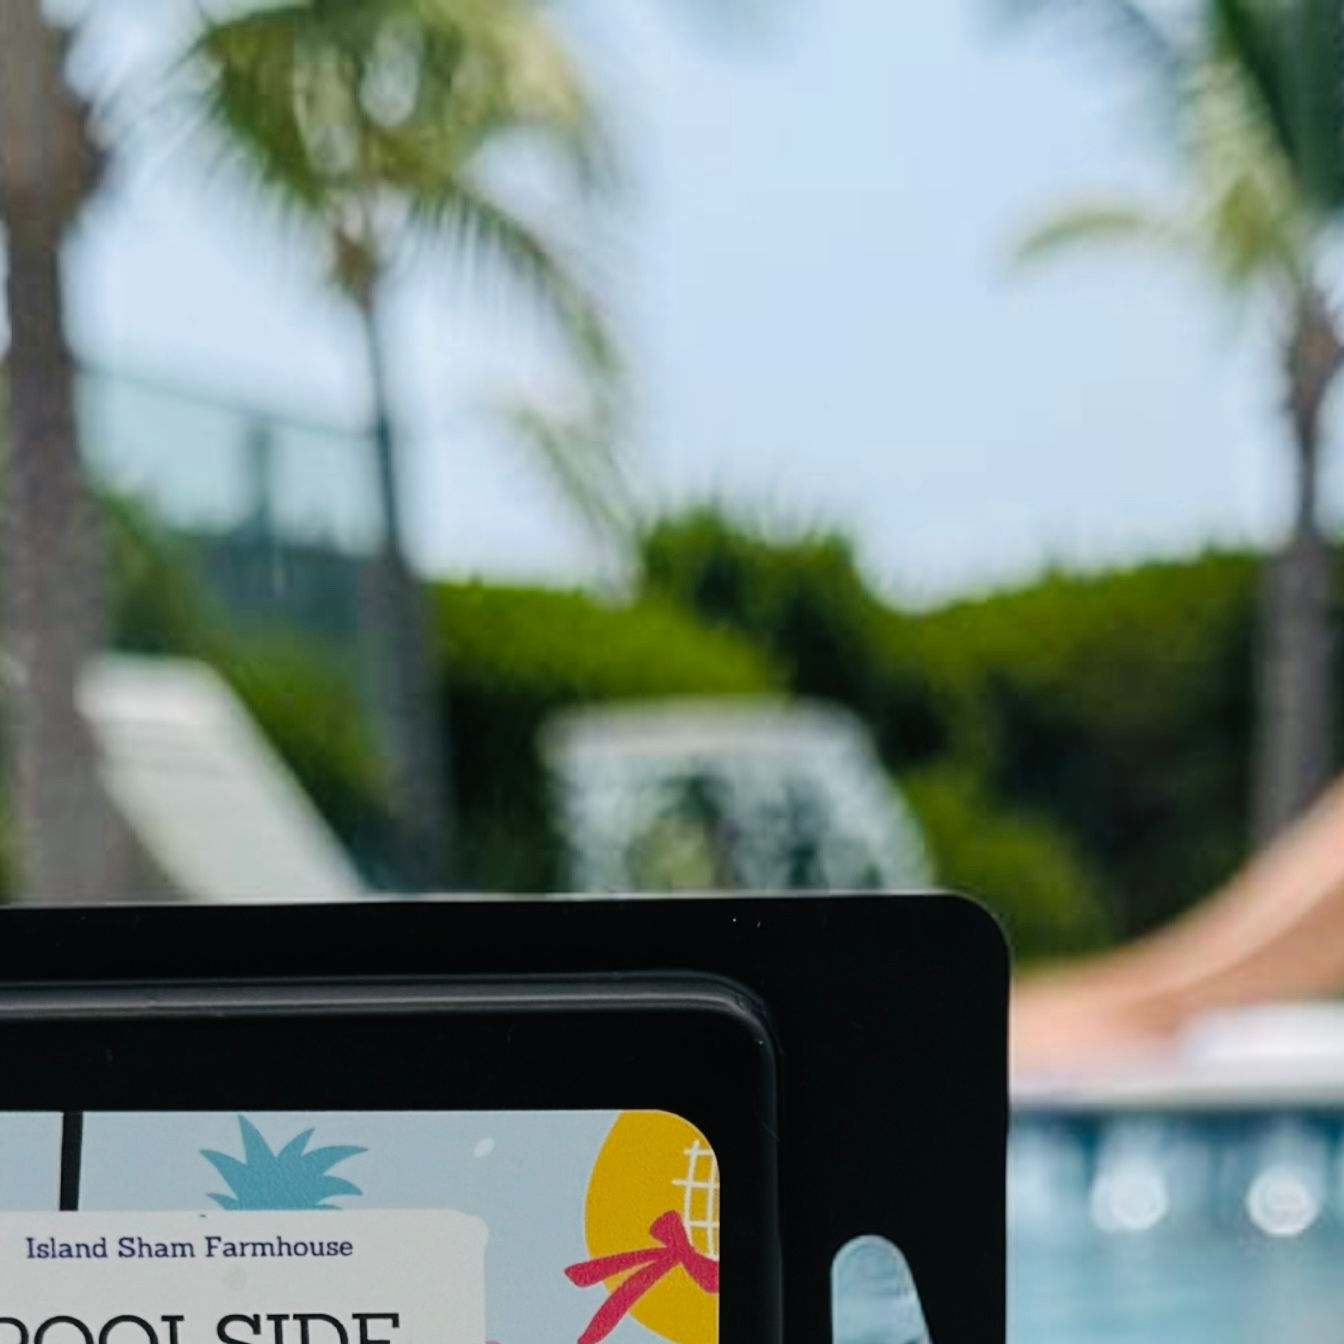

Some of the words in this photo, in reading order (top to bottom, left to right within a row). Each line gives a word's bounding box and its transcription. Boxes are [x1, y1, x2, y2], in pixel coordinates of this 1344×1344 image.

[25, 1236, 109, 1259] Island
[117, 1236, 196, 1259] Sham
[204, 1235, 354, 1258] Farmhouse
